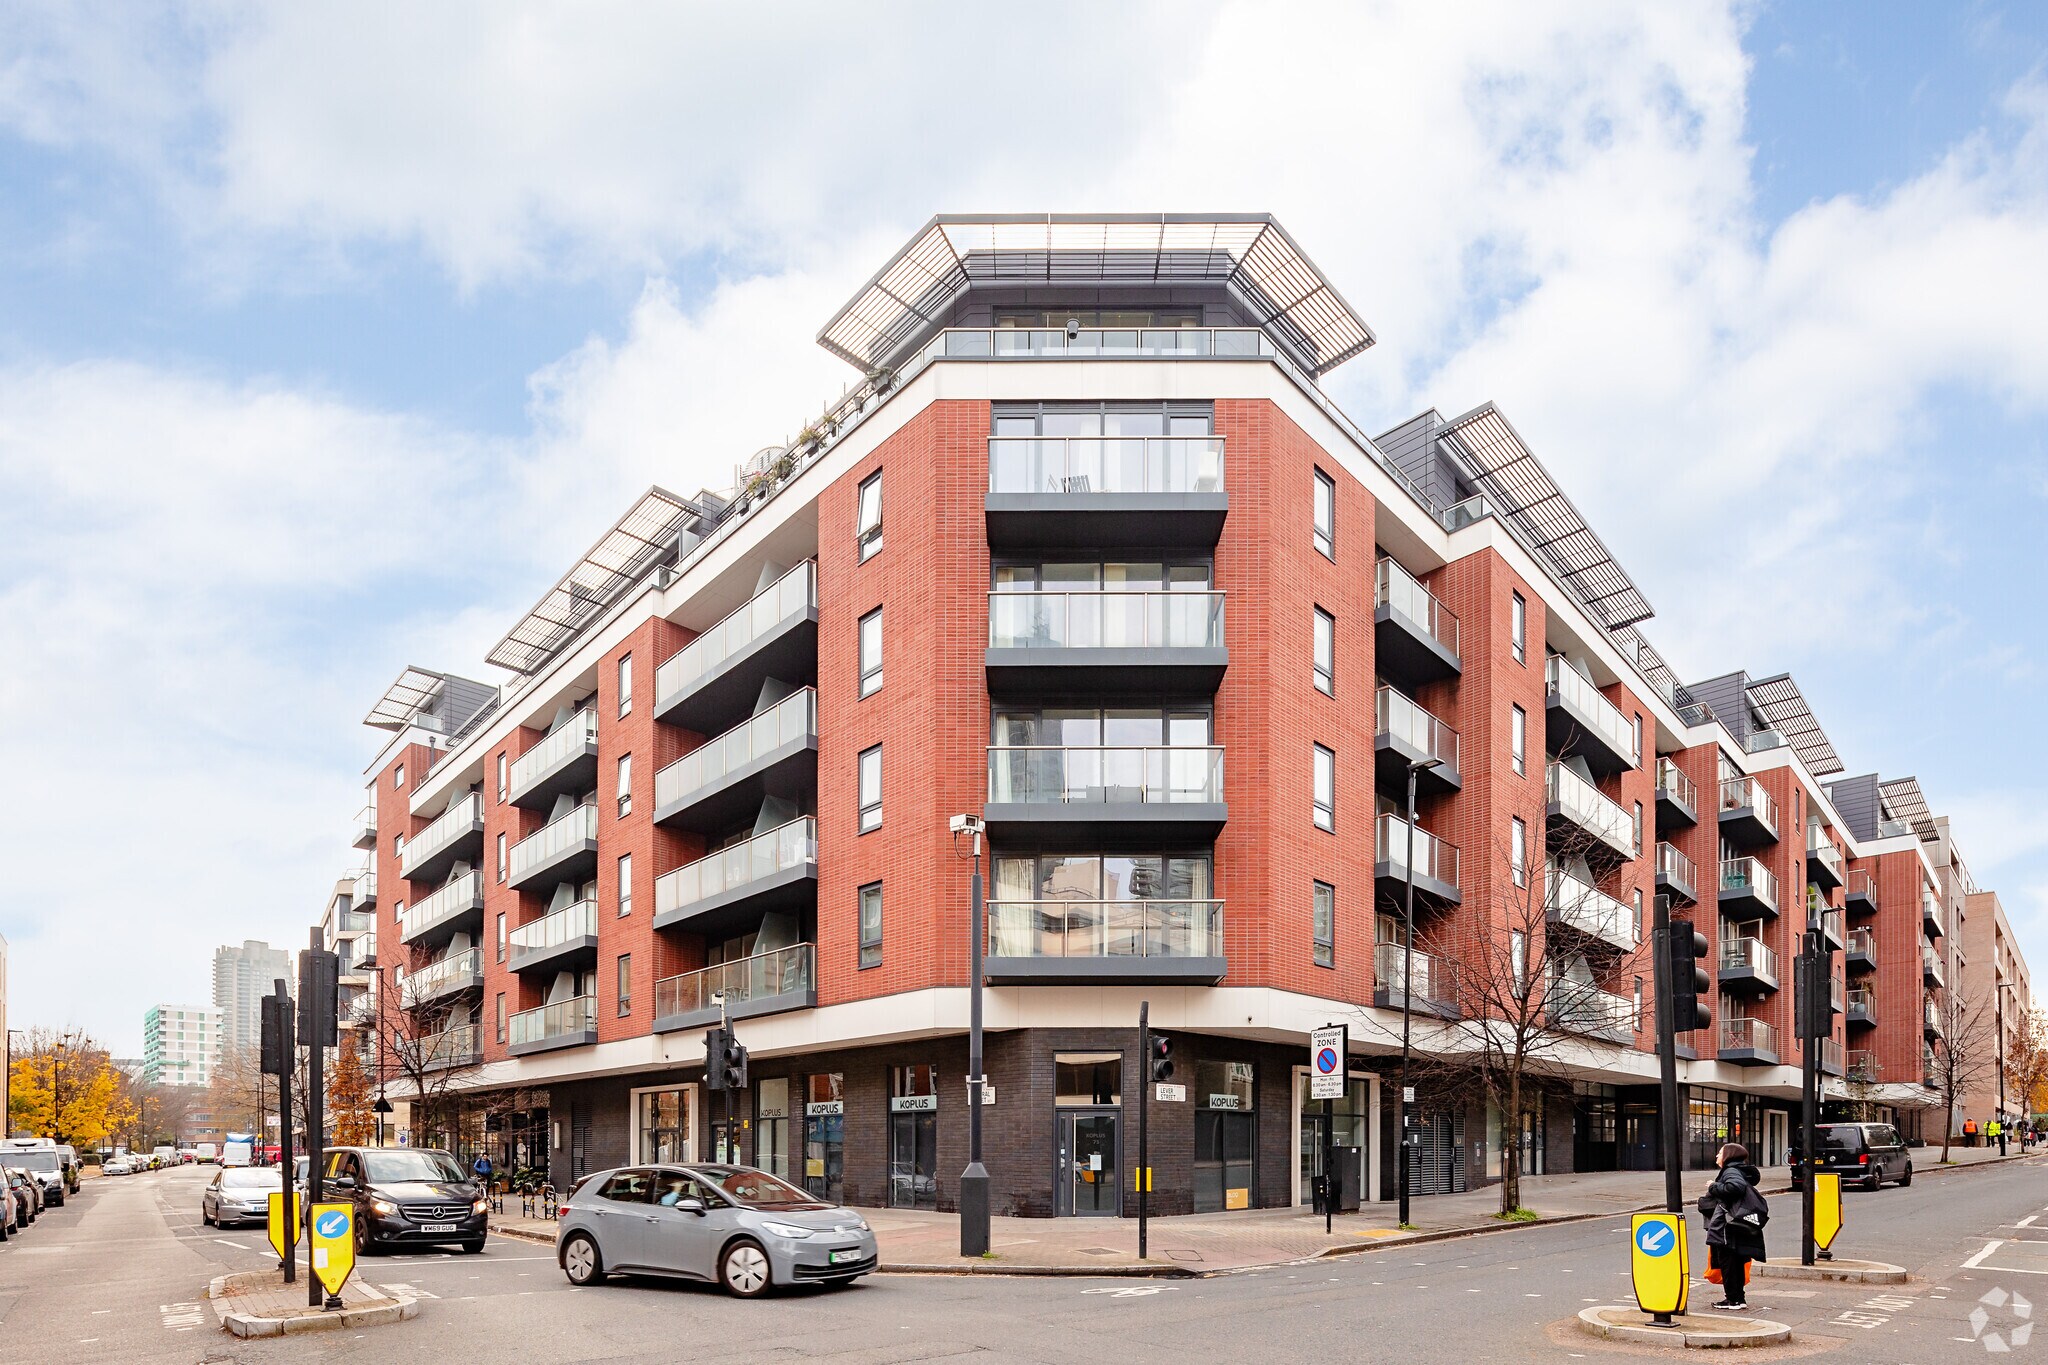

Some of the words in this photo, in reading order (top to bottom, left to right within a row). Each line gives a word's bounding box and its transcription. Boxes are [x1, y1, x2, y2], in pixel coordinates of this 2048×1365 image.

[1313, 1030, 1341, 1039] Controlled
[1317, 1038, 1337, 1047] ZONE
[900, 1098, 929, 1109] KOPLUS
[1211, 1097, 1239, 1108] KOPLUS
[760, 1108, 782, 1117] KOPLUS
[812, 1103, 839, 1114] KOPLUS
